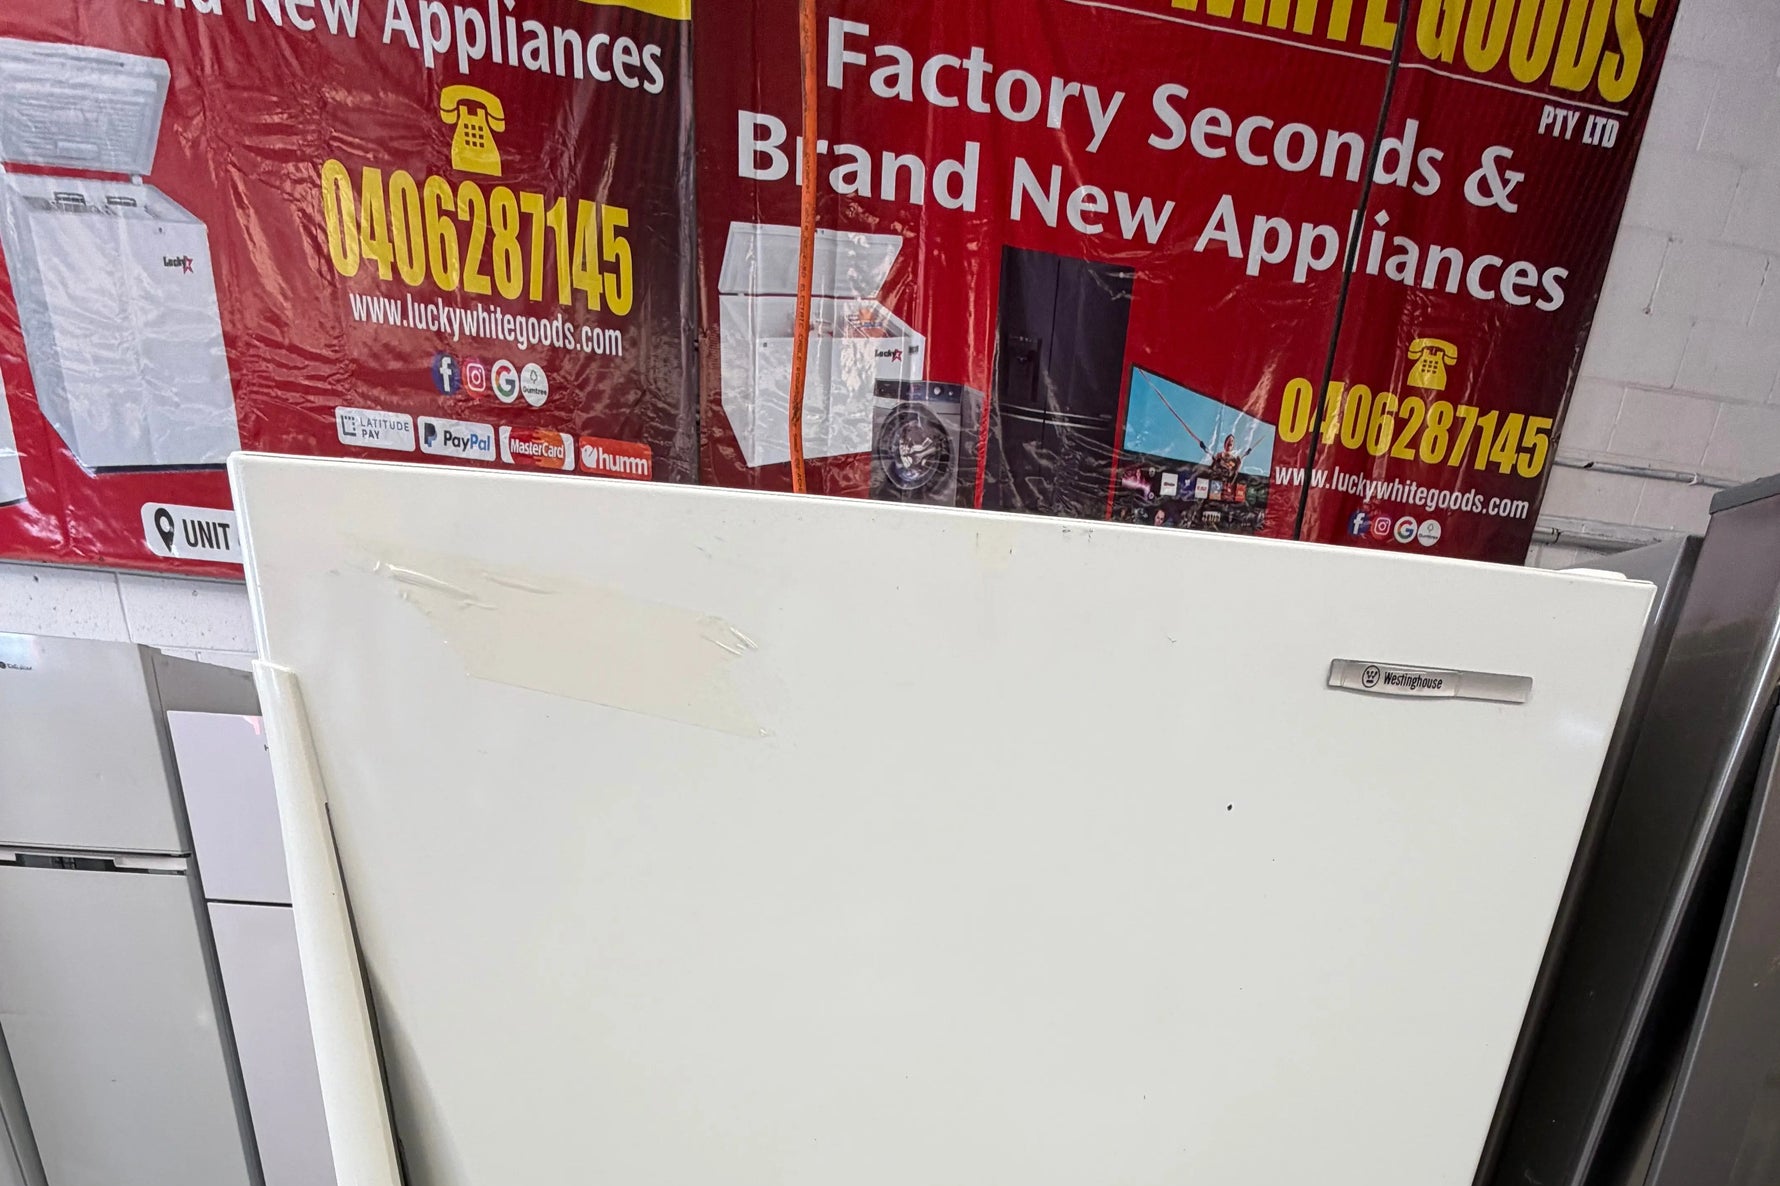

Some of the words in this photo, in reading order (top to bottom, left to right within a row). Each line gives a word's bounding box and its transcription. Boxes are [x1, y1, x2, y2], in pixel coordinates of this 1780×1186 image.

[383, 0, 663, 94] Appliances
[827, 16, 1126, 153] Factory
[1148, 83, 1444, 196] Seconds
[1463, 145, 1525, 213] &
[1538, 105, 1580, 139] PTY
[1582, 115, 1620, 148] LTD
[737, 110, 980, 212] Brand
[1010, 157, 1175, 244] New
[1194, 194, 1569, 311] Appliances
[321, 159, 633, 316] 0406287145
[350, 293, 622, 356] www.luckywhitegoods.com
[360, 418, 410, 433] LATITUDE
[361, 429, 380, 441] PAY
[444, 430, 491, 453] PayPal
[1278, 377, 1553, 478] 0406287145
[510, 439, 564, 461] MasterCard
[598, 448, 648, 477] humm
[1275, 466, 1529, 519] www.luckywhitegoods.com
[182, 518, 230, 551] UNIT
[1384, 671, 1443, 690] Westinghouse
